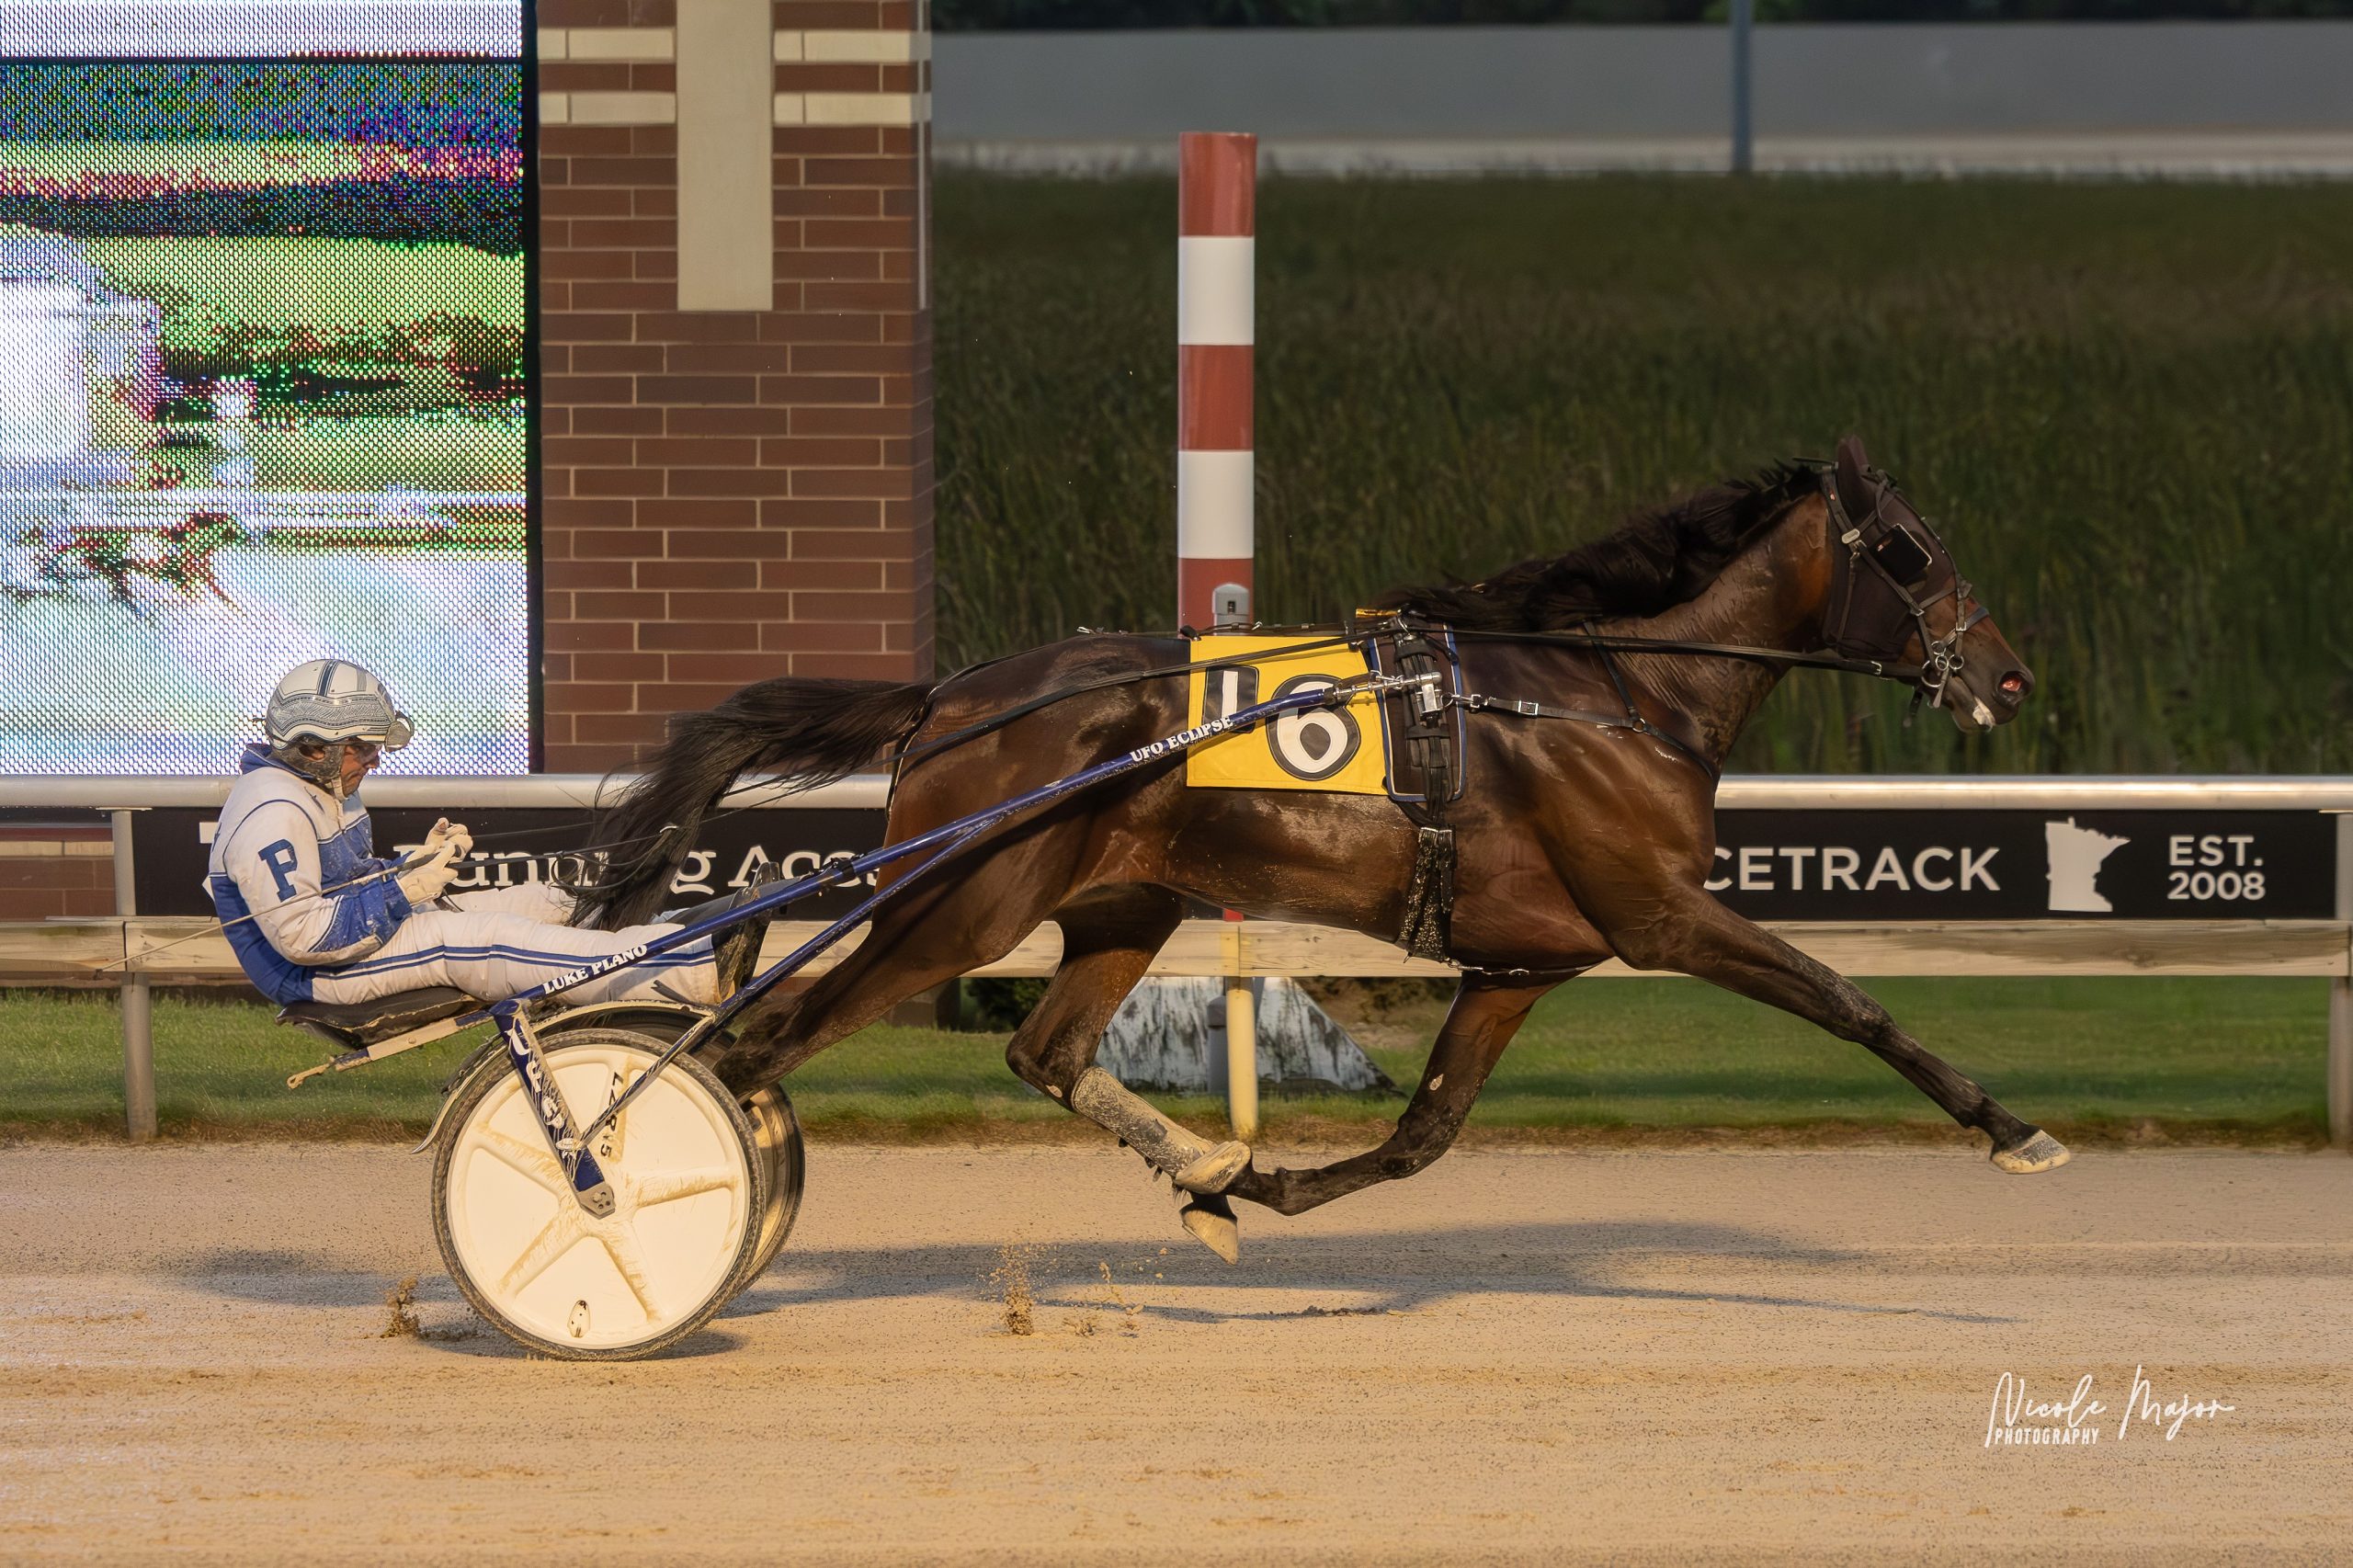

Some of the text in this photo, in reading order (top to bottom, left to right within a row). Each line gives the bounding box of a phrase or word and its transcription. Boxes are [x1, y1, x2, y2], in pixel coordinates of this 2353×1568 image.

[1130, 716, 1233, 762] UFO ECLIPSE
[1206, 666, 1360, 780] 16
[258, 838, 298, 903] P
[2169, 835, 2263, 867] EST.
[2167, 871, 2267, 900] 2008
[542, 945, 648, 994] LUKE PLANO
